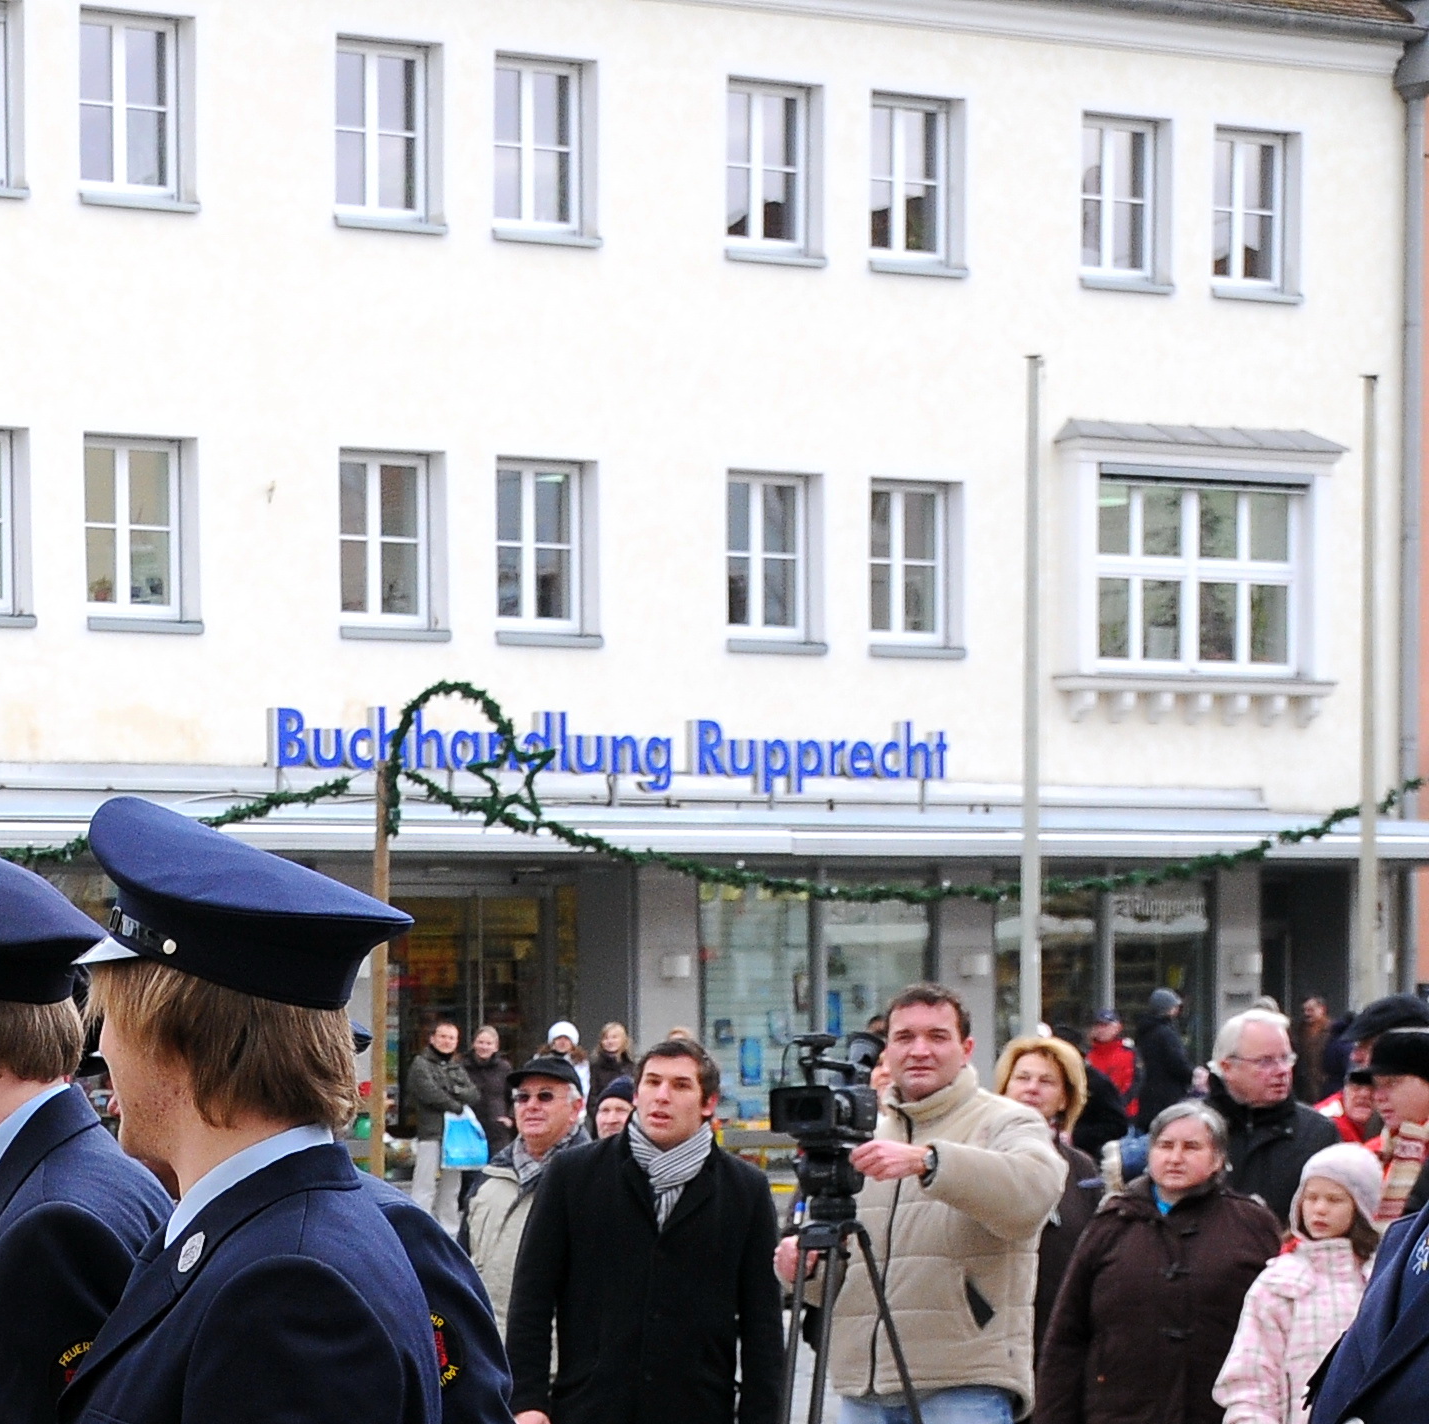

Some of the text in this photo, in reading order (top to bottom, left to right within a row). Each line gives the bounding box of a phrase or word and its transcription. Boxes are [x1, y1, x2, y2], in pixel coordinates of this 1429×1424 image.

[266, 706, 949, 794] Buchhandlung Rupprecht
[58, 1341, 94, 1368] FEUER
